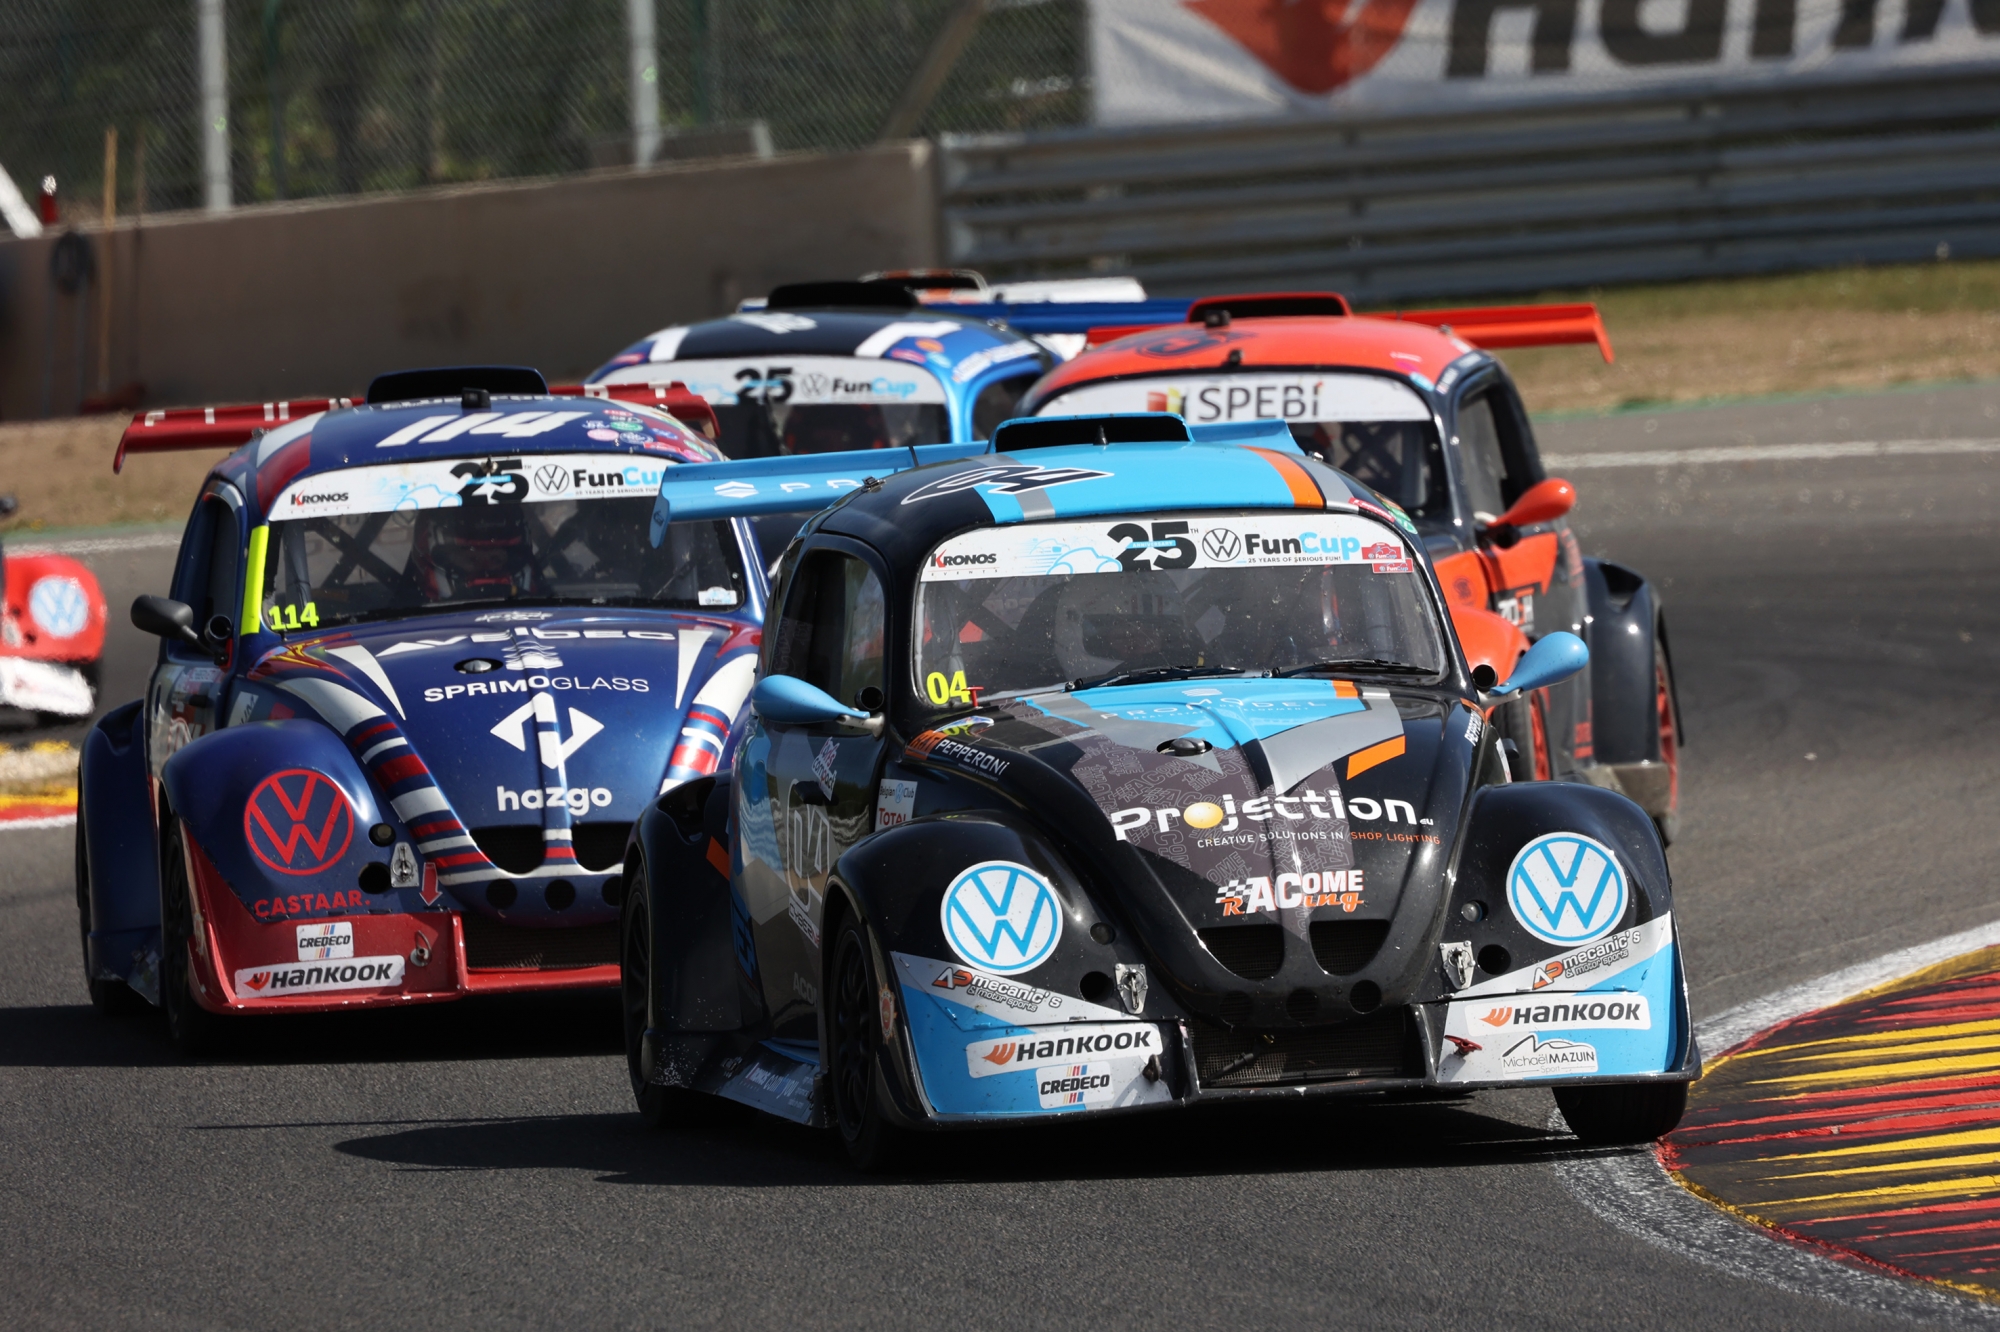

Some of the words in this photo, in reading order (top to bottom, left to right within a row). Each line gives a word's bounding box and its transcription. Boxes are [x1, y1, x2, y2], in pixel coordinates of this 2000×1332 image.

[734, 367, 794, 403] 25
[832, 377, 917, 397] FunCup
[449, 459, 529, 503] 25
[930, 549, 997, 568] KRONOS
[1106, 521, 1197, 570] 25
[1245, 532, 1361, 560] FunCup
[269, 602, 319, 631] 114
[424, 676, 649, 702] SPRIMOGLASS
[927, 670, 970, 705] 04
[497, 786, 612, 816] hazgo
[1197, 834, 1255, 848] CREATIVE
[1260, 831, 1326, 842] SOLUTIONS
[1331, 831, 1344, 840] IN
[1351, 831, 1382, 840] SHOP
[1387, 832, 1441, 845] LIGHTING
[299, 935, 350, 948] CREDECO
[1040, 1074, 1110, 1095] CREDECO
